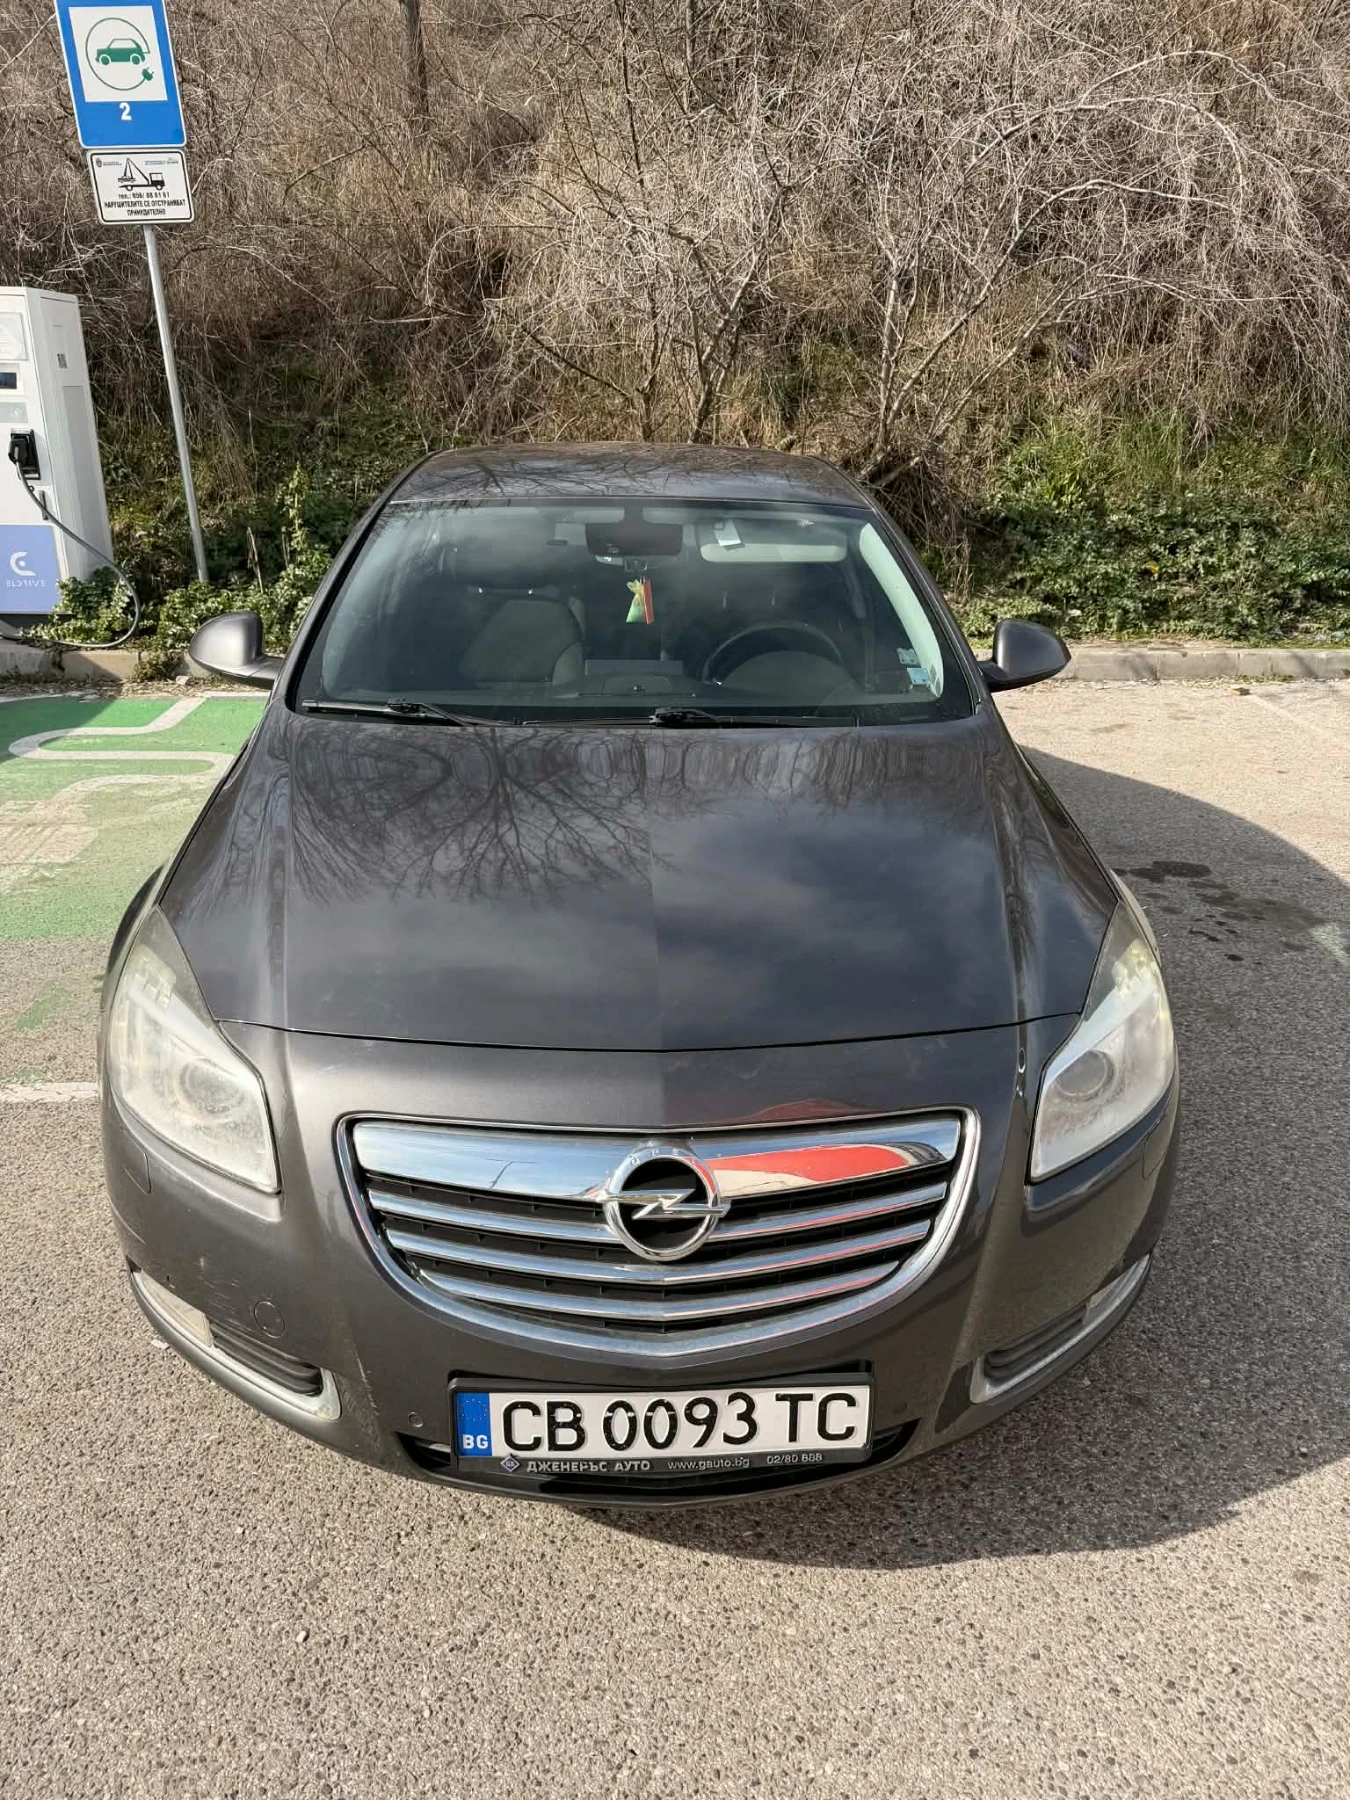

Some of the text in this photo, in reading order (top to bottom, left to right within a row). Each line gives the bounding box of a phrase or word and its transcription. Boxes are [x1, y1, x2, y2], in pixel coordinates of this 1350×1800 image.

[119, 102, 132, 120] 2
[503, 1391, 857, 1452] CB 0093 TC
[462, 1434, 489, 1450] BG
[667, 1456, 750, 1470] www.gauto.bg
[766, 1452, 823, 1465] 02/80 888
[526, 1460, 651, 1473] ДЖЕНЕРЪС АУТО
